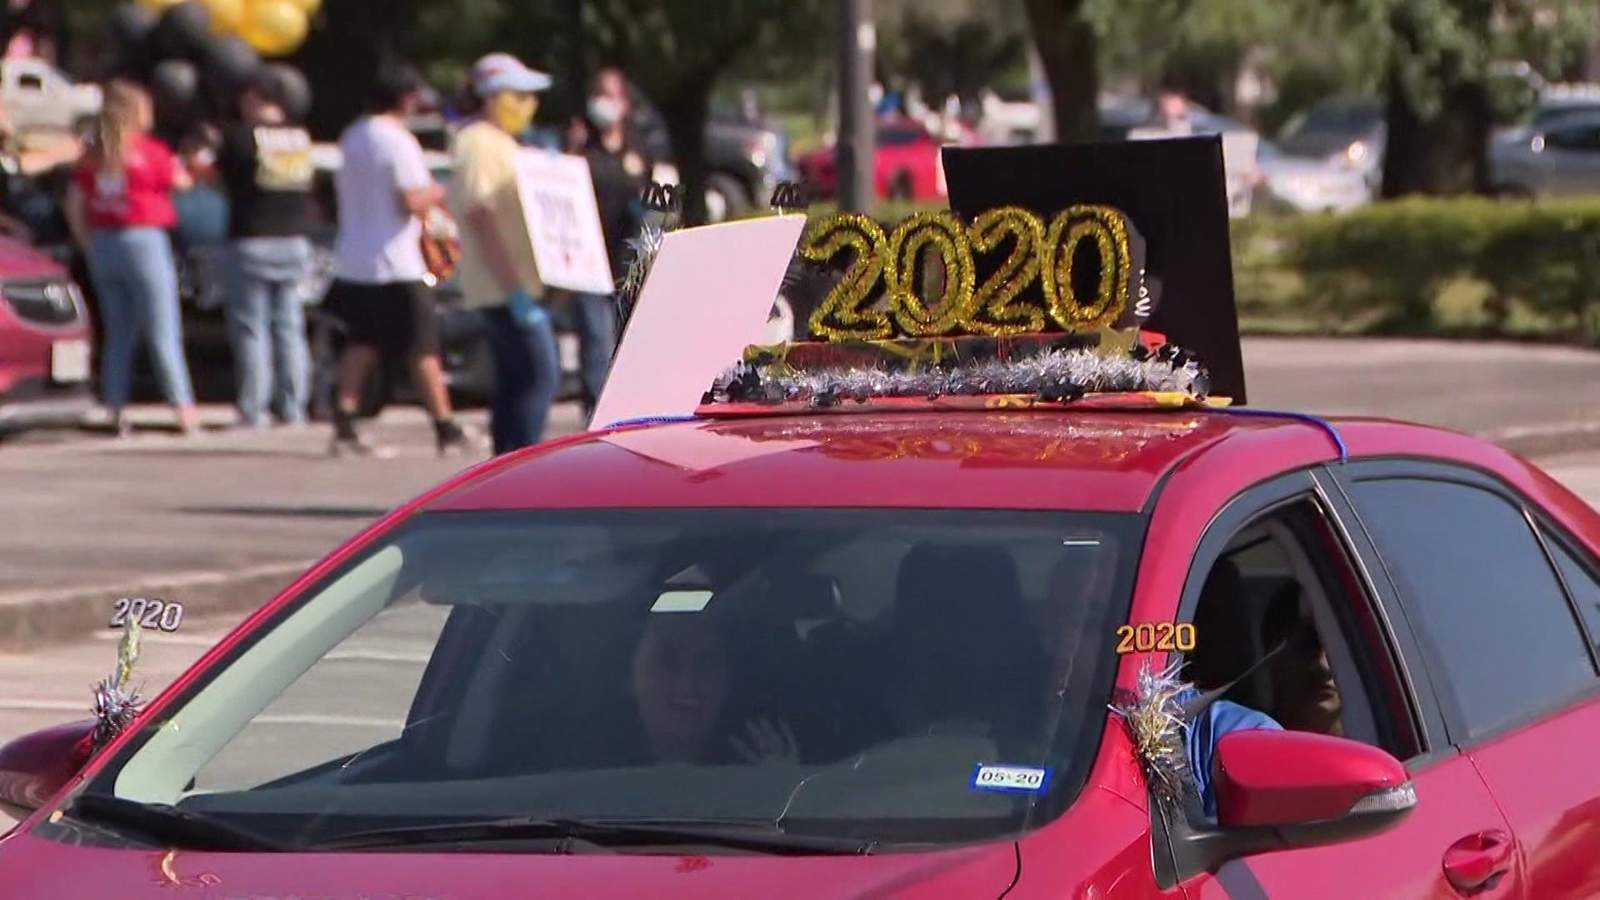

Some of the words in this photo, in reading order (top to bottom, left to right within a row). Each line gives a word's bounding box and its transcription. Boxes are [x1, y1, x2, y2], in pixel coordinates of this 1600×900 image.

[799, 204, 1132, 342] 2020
[109, 598, 183, 632] 2020
[1115, 622, 1197, 655] 2020
